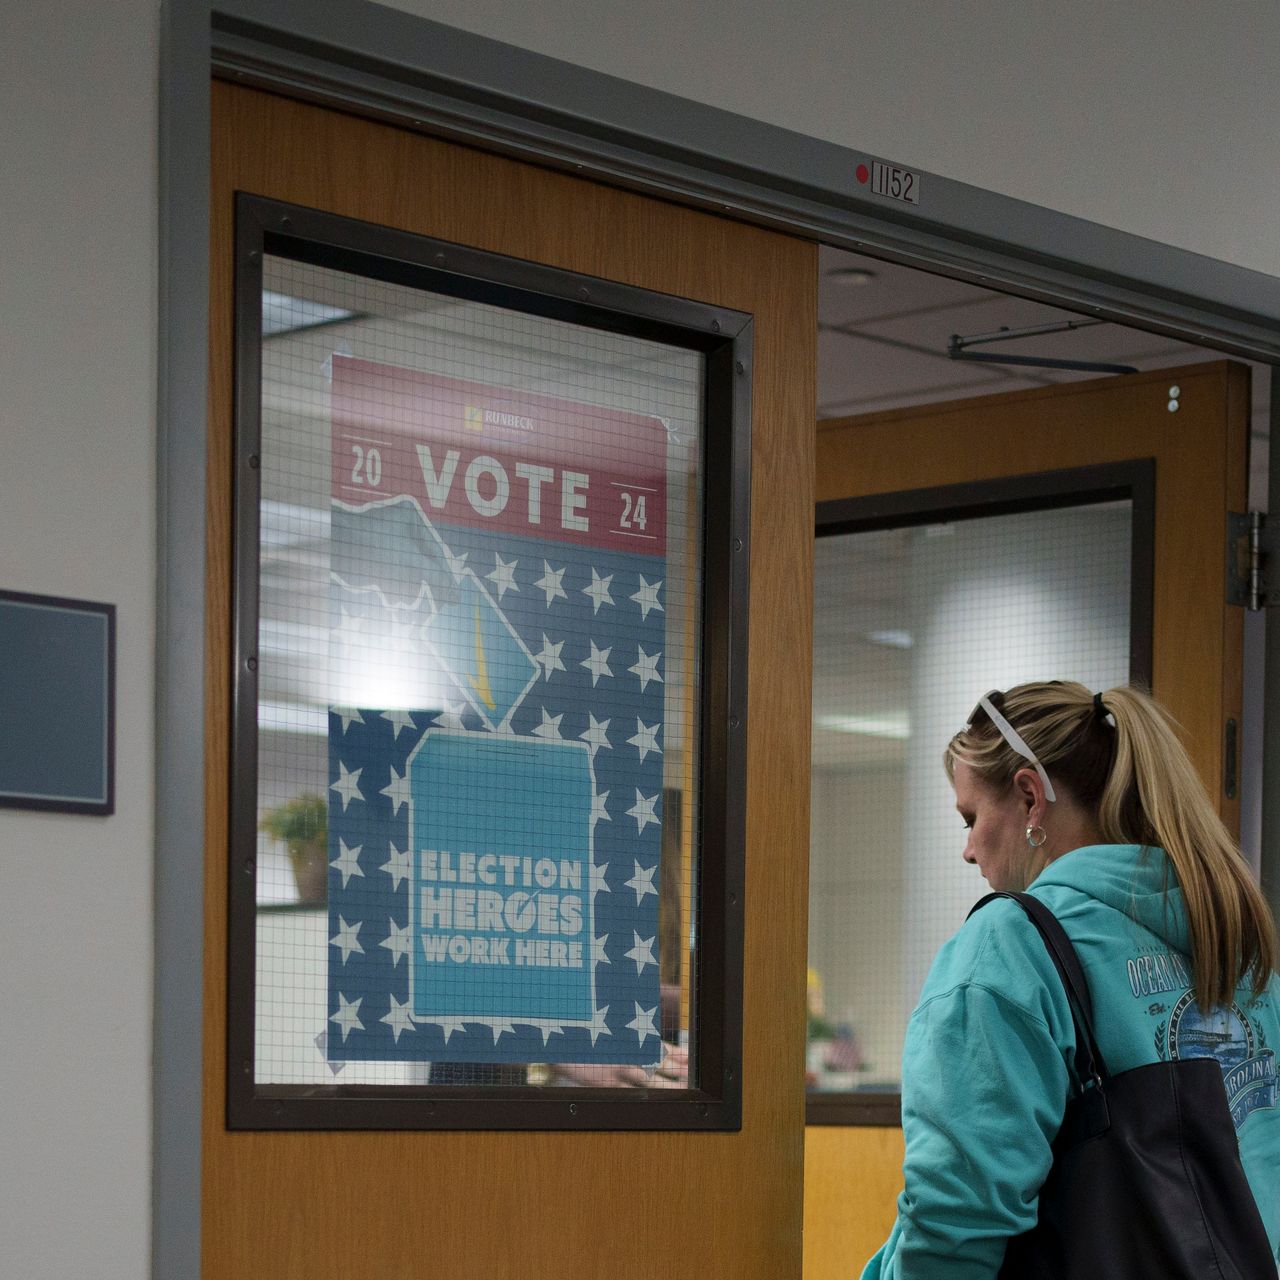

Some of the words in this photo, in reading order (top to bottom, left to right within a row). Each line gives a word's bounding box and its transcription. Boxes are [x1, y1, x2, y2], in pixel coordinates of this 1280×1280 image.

[879, 165, 914, 202] 1152
[485, 409, 535, 431] RUNBECK
[351, 445, 382, 487] 20
[416, 444, 590, 532] VOTE
[620, 493, 648, 530] 24
[420, 850, 582, 889] ELECTION
[420, 886, 583, 936] HEROES
[422, 933, 510, 965] WORK
[516, 938, 583, 968] HERE
[1127, 954, 1176, 998] OCEAN
